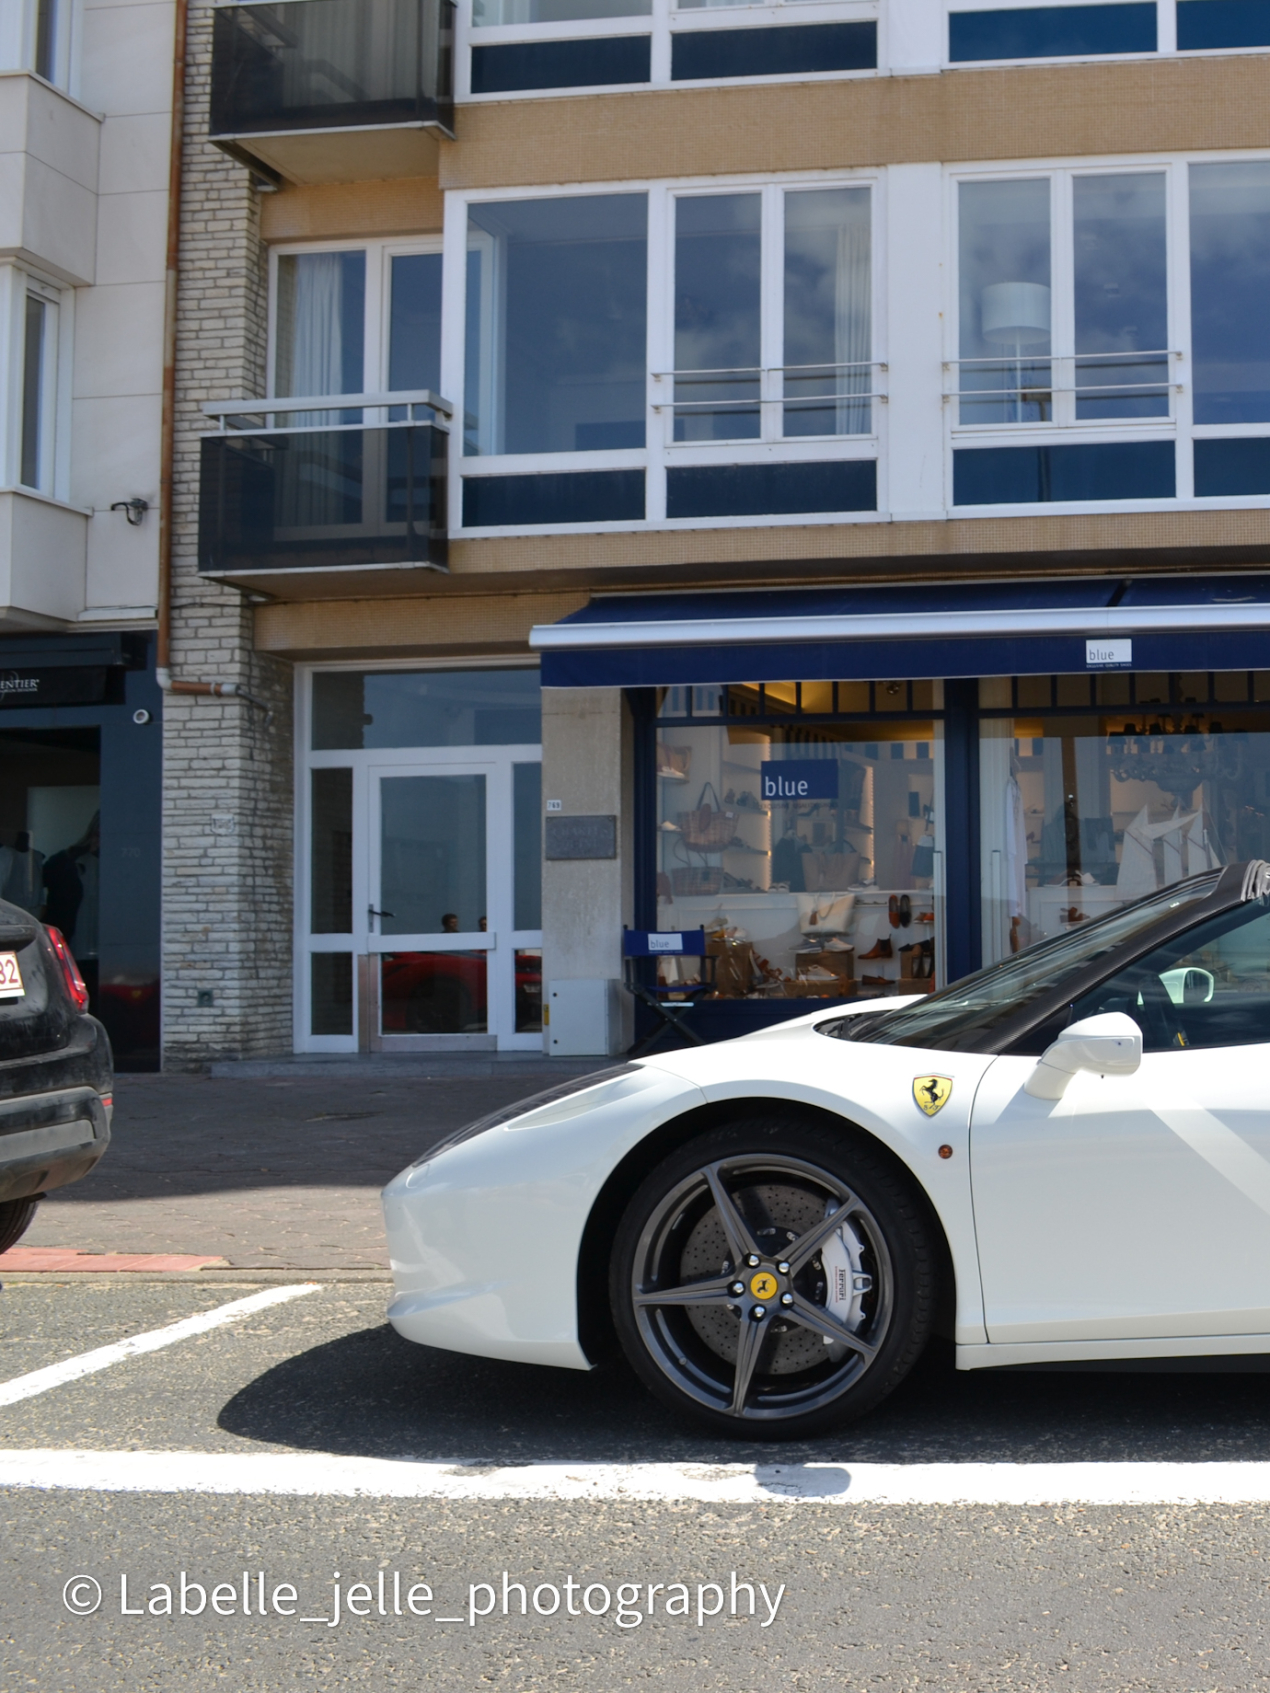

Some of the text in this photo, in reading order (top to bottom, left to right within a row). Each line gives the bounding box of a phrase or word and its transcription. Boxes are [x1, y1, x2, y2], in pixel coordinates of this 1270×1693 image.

[1089, 649, 1115, 661] blue
[765, 776, 808, 796] blue
[650, 940, 670, 949] blue
